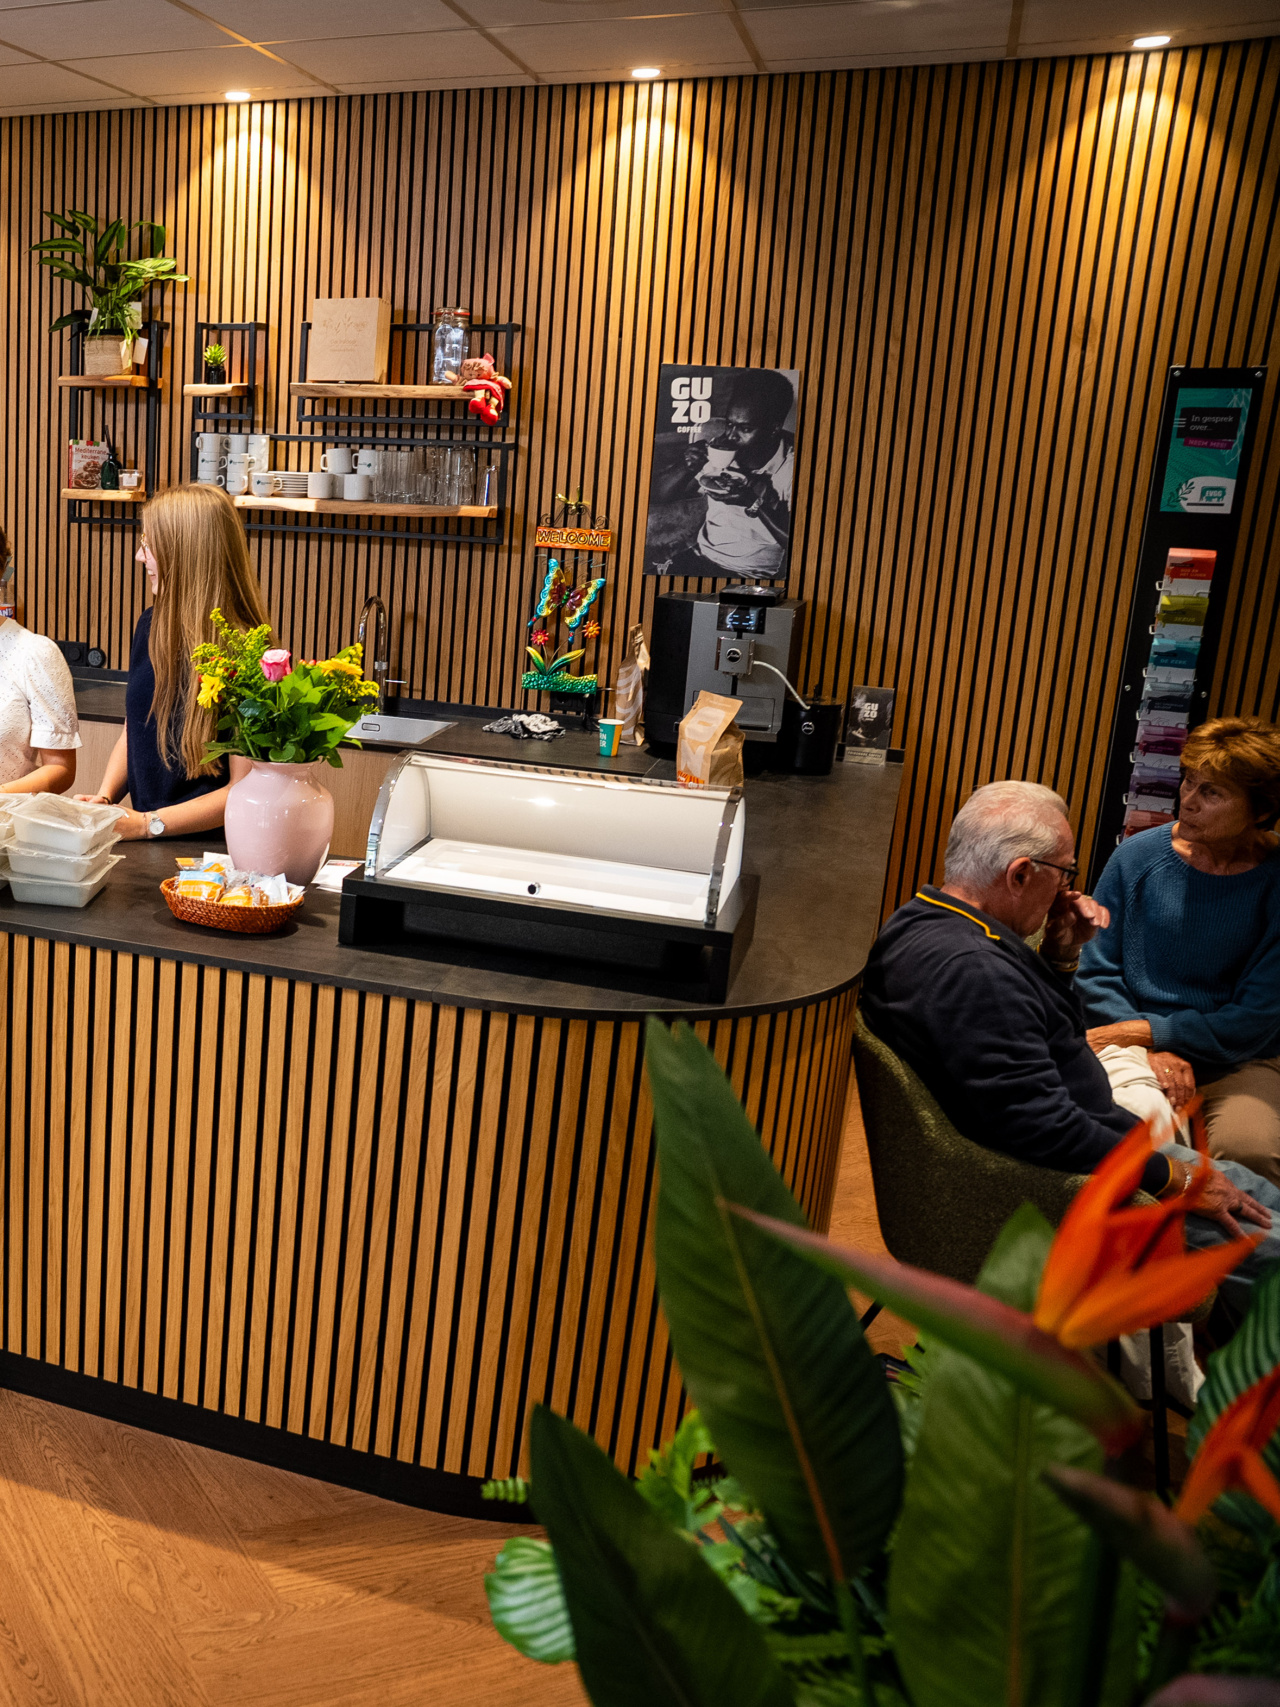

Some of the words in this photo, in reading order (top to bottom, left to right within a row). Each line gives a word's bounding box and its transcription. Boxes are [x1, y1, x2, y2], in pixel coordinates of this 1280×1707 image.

[671, 377, 713, 400] GU
[671, 400, 712, 424] ZO
[1202, 415, 1233, 424] gesprek
[537, 530, 610, 547] WELCOME
